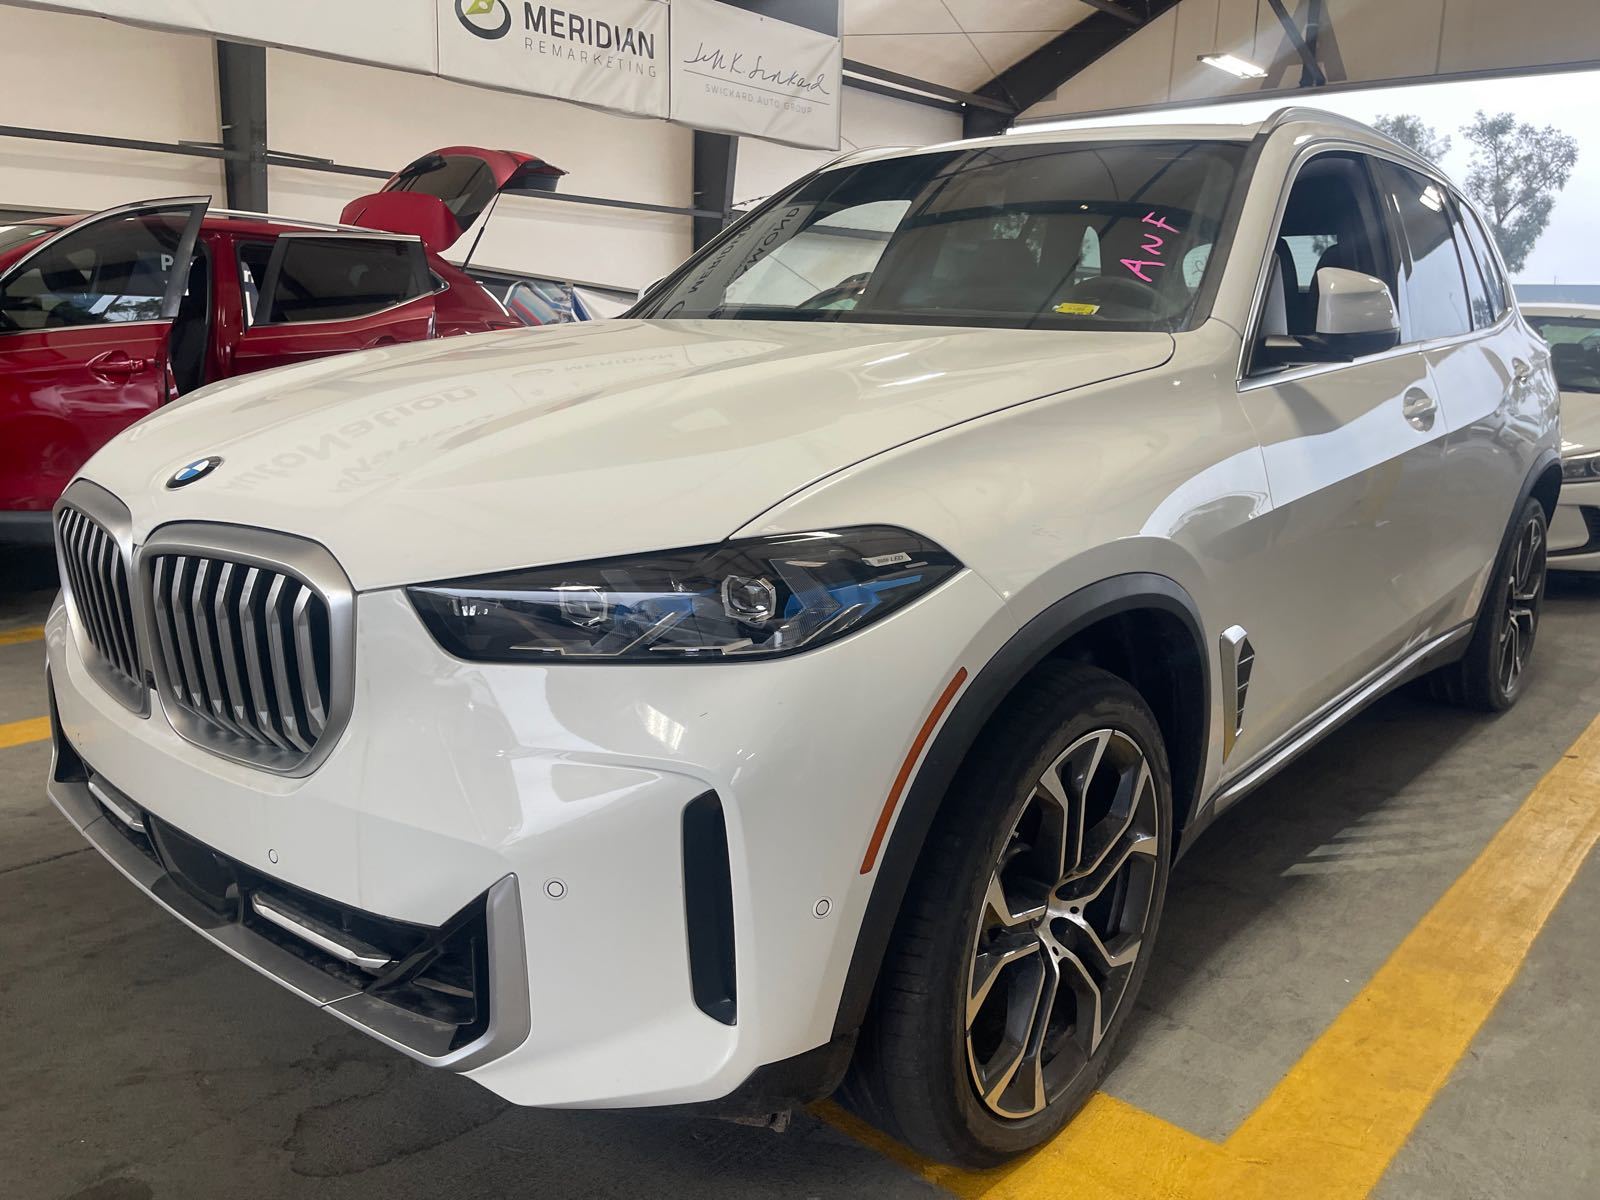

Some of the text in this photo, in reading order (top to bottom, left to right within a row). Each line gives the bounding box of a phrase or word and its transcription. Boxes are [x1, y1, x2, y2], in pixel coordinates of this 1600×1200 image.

[524, 2, 654, 59] MERIDIAN
[525, 37, 656, 77] REMARKETING
[705, 83, 813, 115] SWICKARD AUTO GROUP
